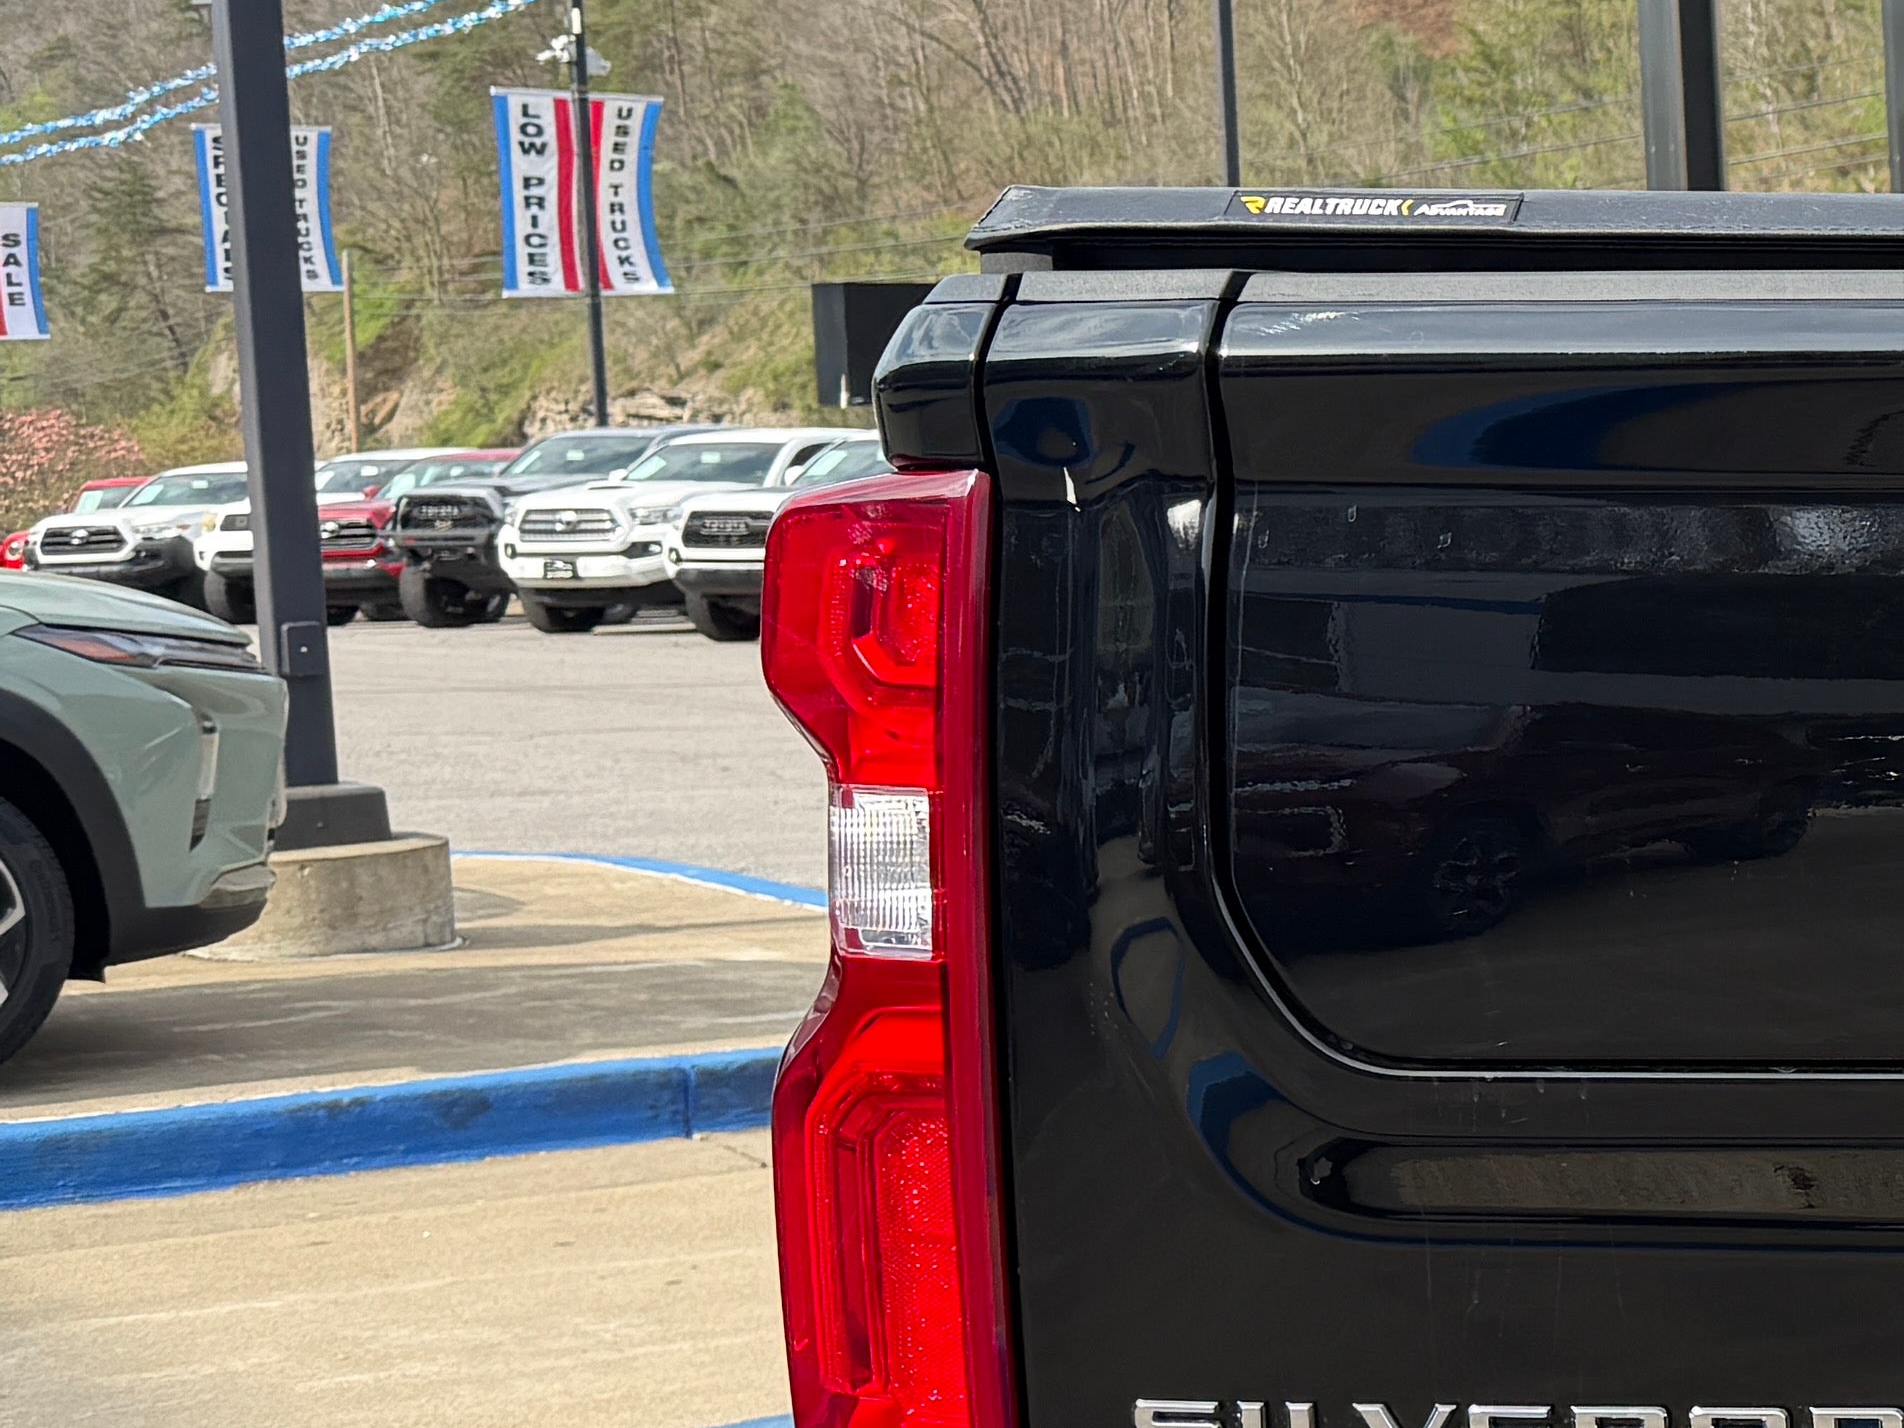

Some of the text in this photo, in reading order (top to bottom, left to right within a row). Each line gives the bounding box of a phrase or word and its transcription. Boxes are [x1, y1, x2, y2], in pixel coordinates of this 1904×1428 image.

[517, 103, 551, 286] LOW PRICES
[609, 107, 641, 284] USED TRUCKS
[1265, 197, 1403, 216] REALTRUCK
[1, 232, 26, 307] SALE
